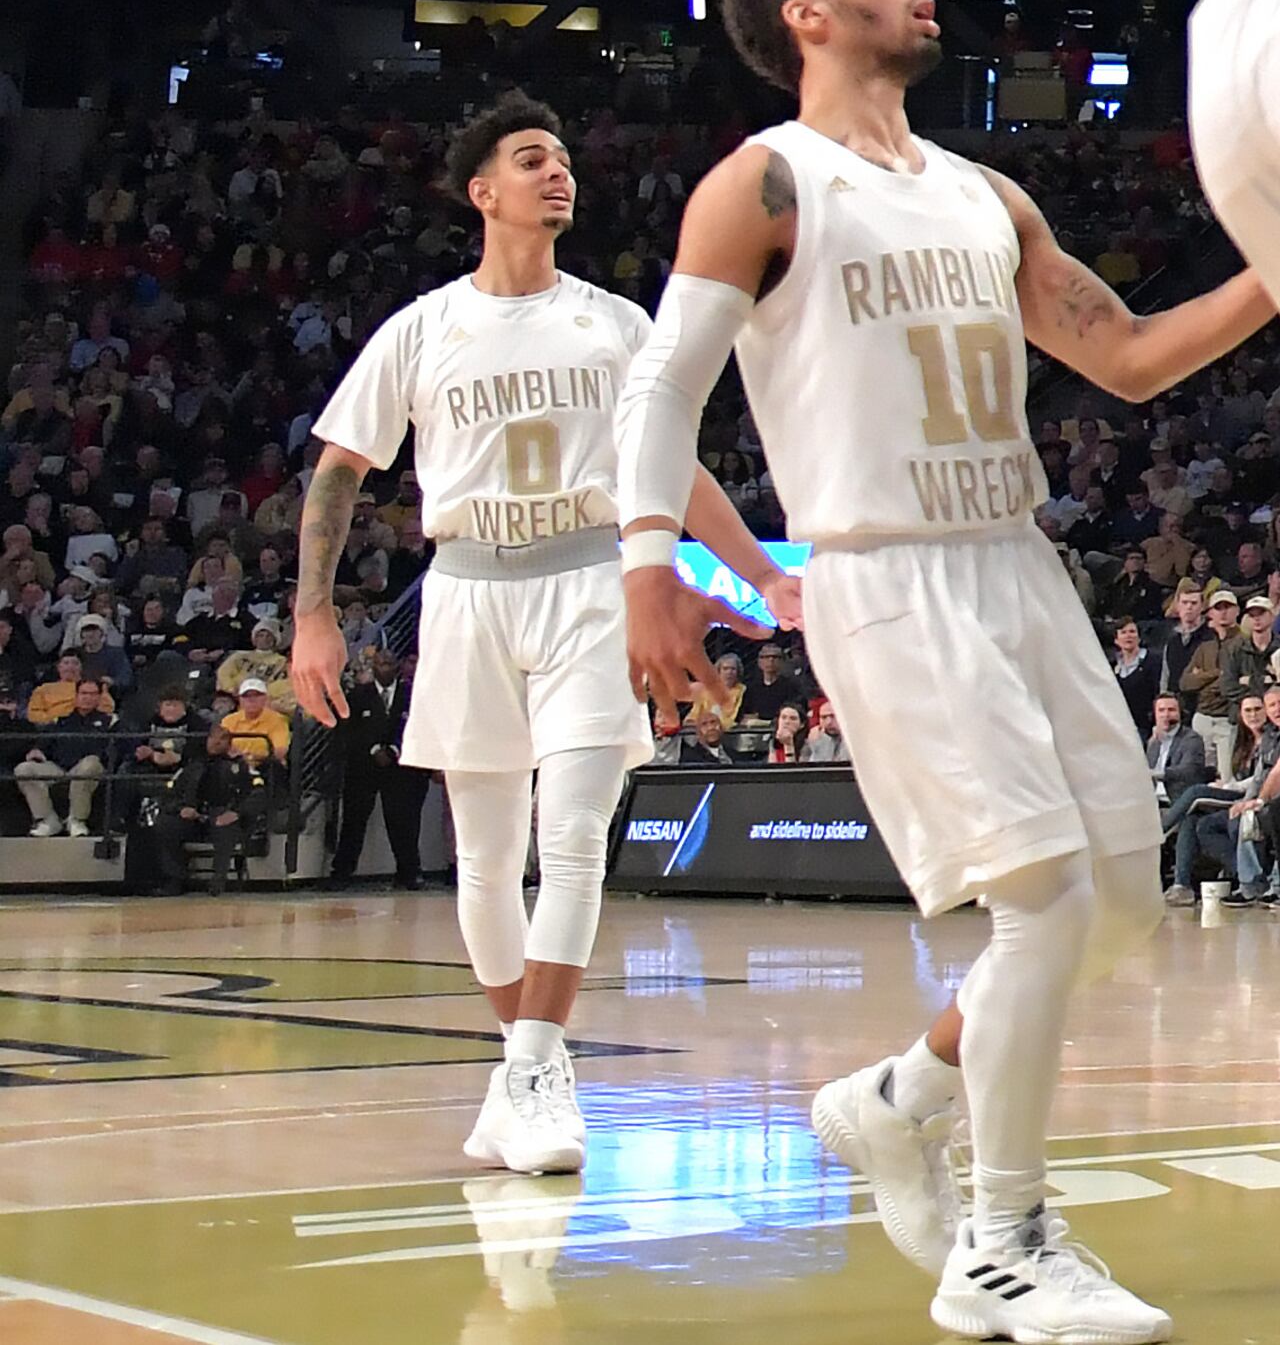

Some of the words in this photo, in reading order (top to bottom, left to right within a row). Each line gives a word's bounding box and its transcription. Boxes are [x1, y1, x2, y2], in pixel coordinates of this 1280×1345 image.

[907, 321, 1022, 447] 10
[505, 419, 563, 496] 0
[909, 452, 1036, 523] WRECK
[472, 490, 592, 544] WRECK
[626, 819, 684, 842] NISSAN
[750, 821, 774, 840] and
[773, 820, 811, 841] sideline
[811, 821, 823, 841] to
[824, 820, 868, 842] sideline
